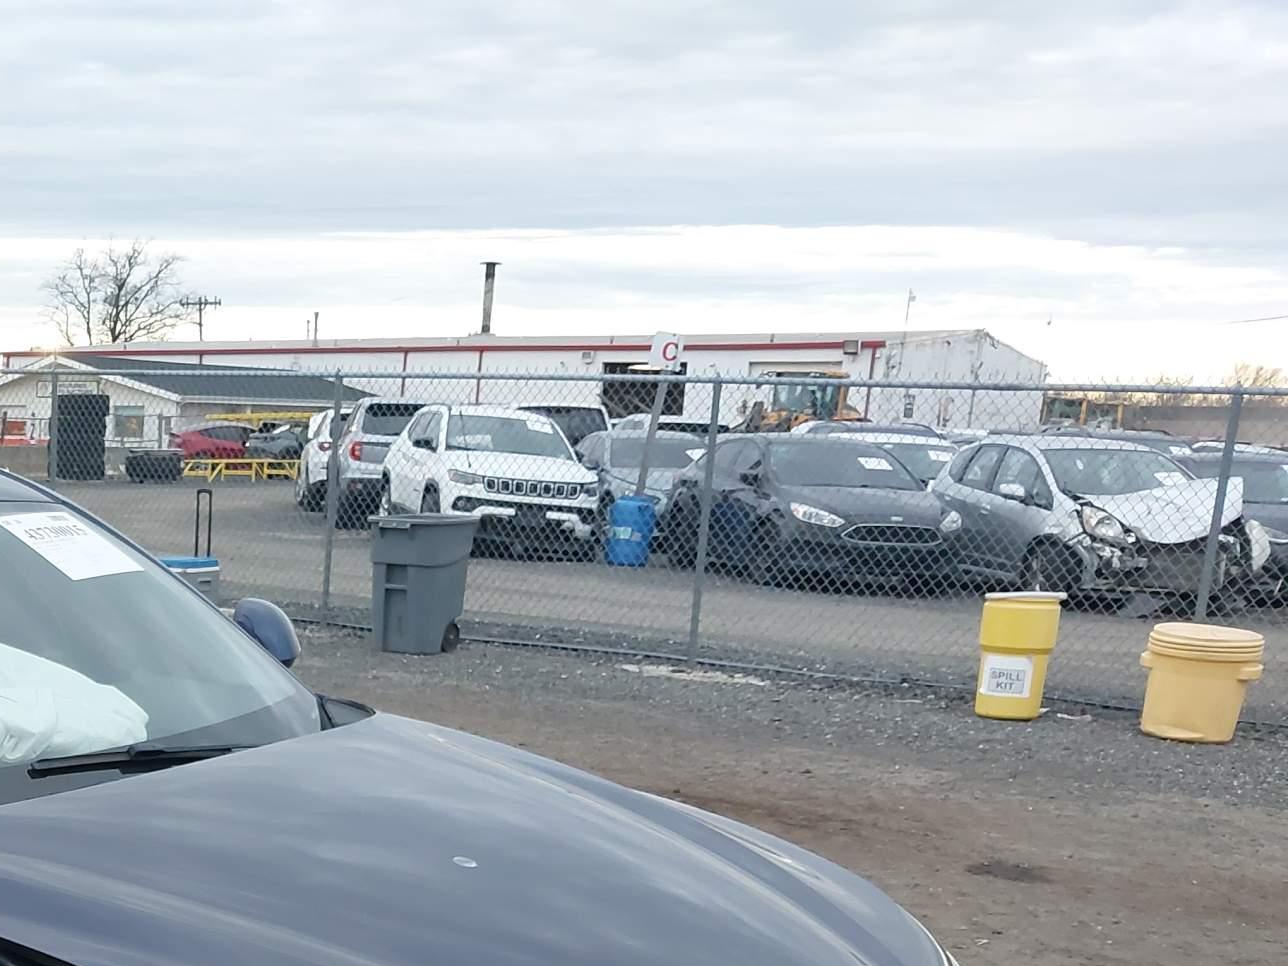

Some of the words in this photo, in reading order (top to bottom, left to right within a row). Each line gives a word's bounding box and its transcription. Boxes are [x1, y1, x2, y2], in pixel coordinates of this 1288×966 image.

[663, 342, 679, 362] C
[992, 670, 1022, 682] SPILL
[996, 680, 1015, 690] KIT
